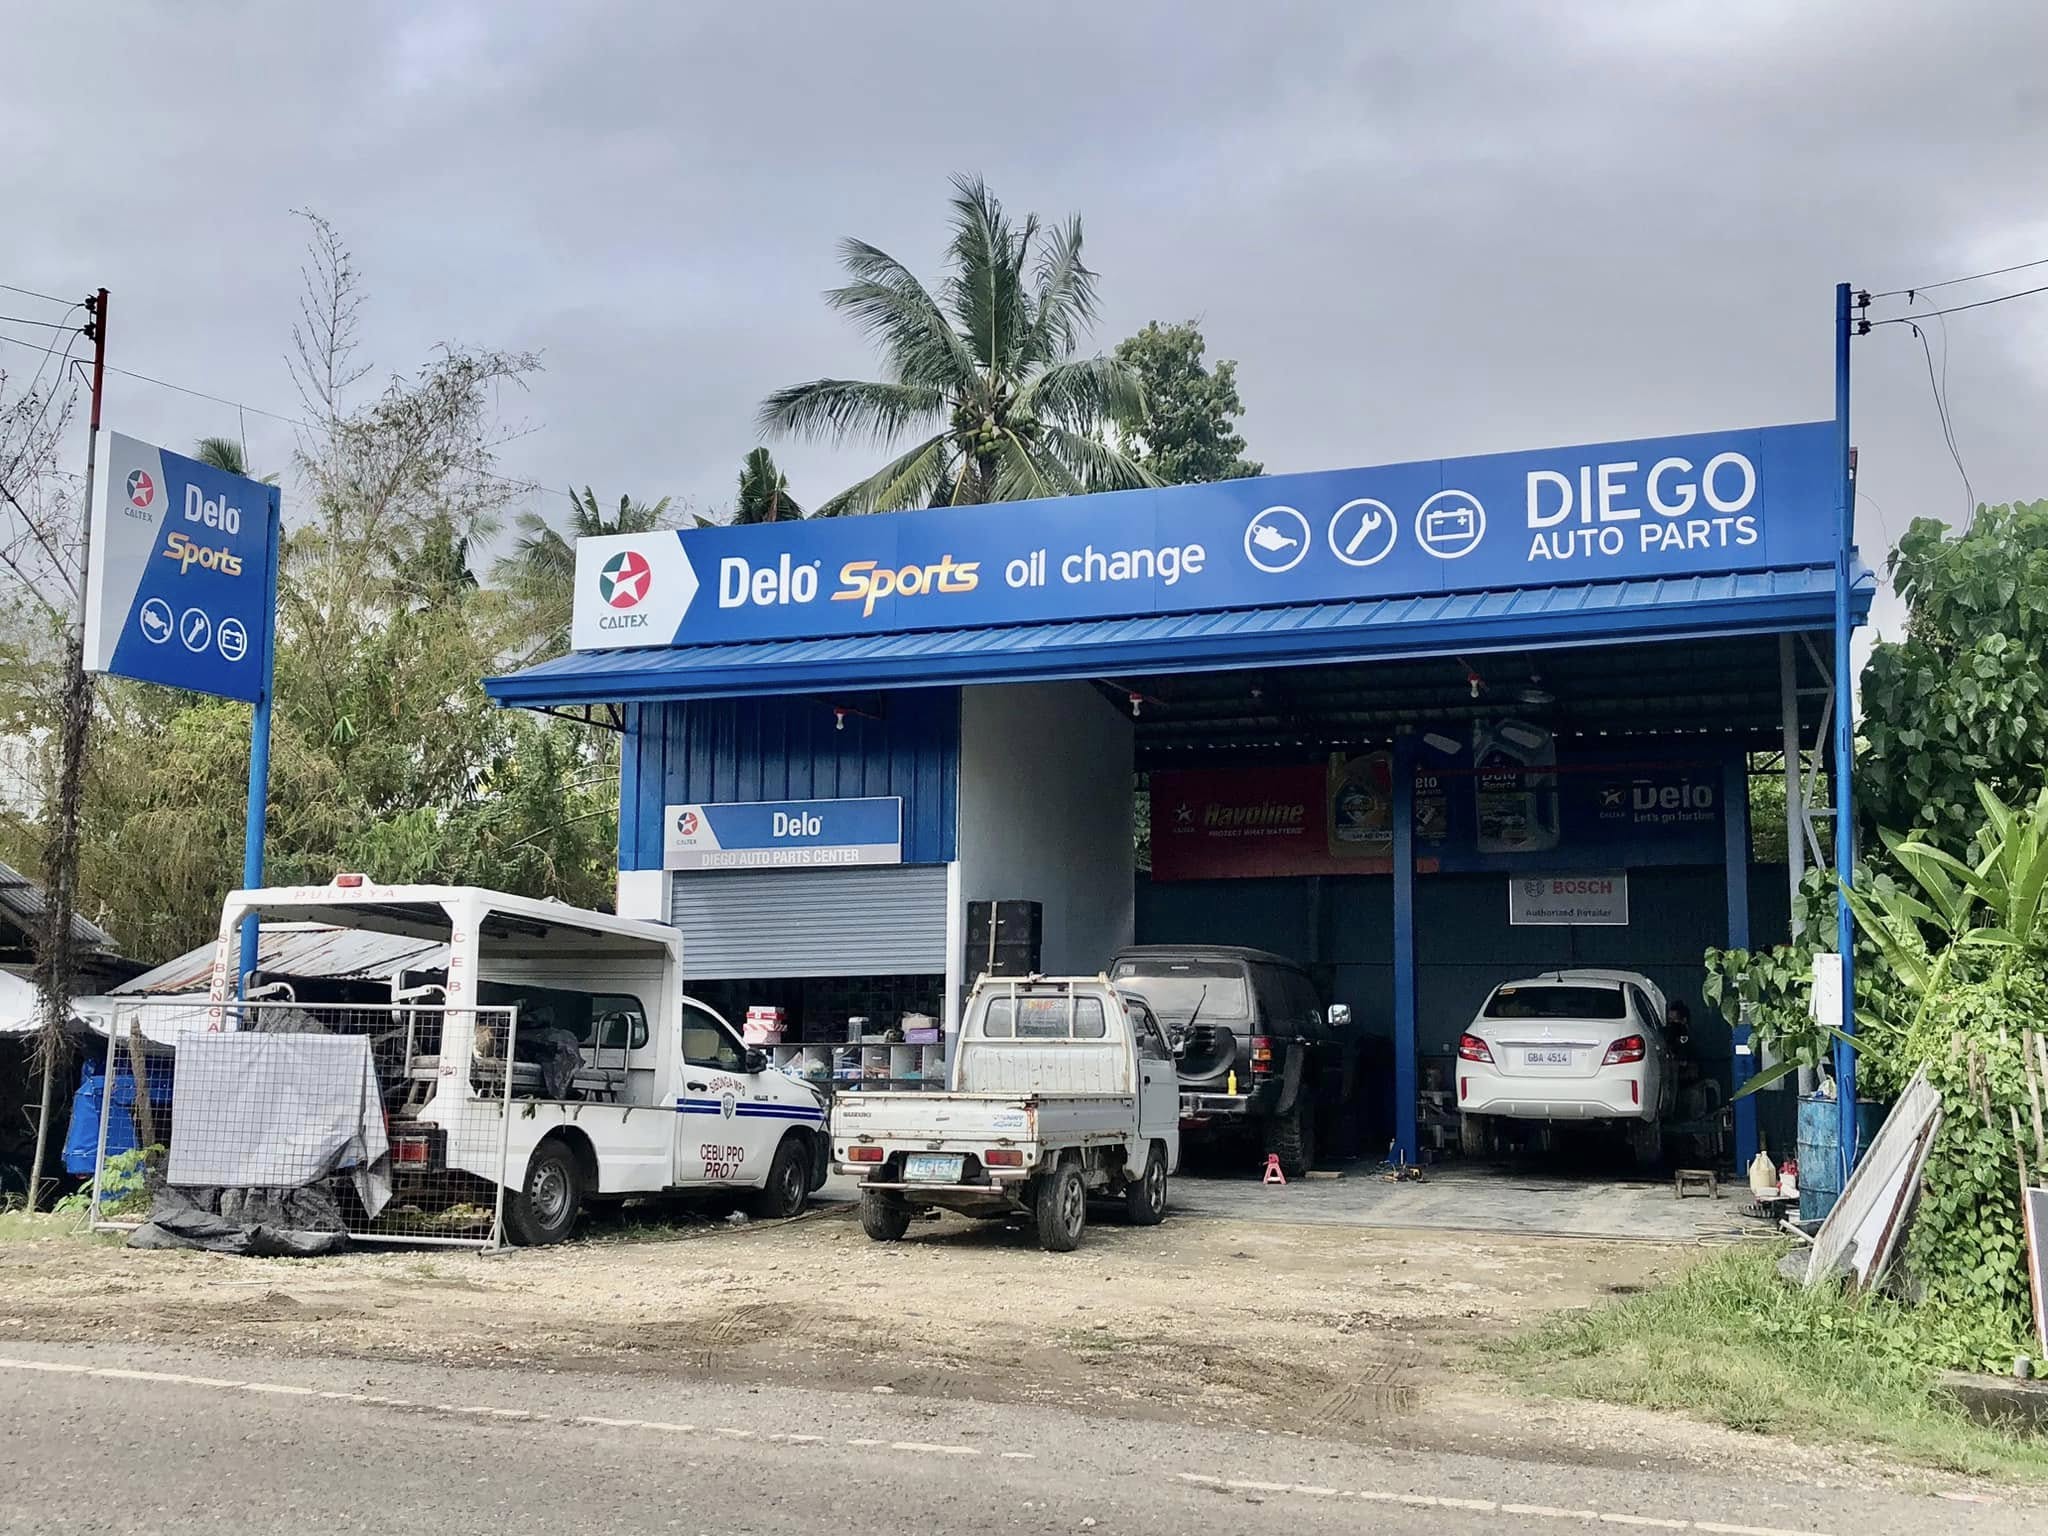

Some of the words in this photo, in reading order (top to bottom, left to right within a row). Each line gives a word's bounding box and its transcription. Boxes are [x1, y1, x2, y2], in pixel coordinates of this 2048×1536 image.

[1526, 452, 1757, 529] DIEGO
[124, 507, 153, 523] CALTEX
[184, 483, 240, 535] Delo
[1527, 526, 1624, 562] AUTO
[1640, 515, 1758, 553] PARTS
[163, 532, 242, 576] Sports
[719, 553, 820, 609] Delo
[831, 555, 979, 617] Sports
[1005, 548, 1046, 588] oil
[1061, 542, 1206, 586] change
[599, 613, 648, 630] CALTEX
[1632, 778, 1713, 810] Delo
[773, 812, 822, 837] Delo
[1206, 801, 1305, 827] Havoline
[702, 851, 736, 867] DIEGO
[739, 850, 770, 865] AUTO
[773, 849, 811, 864] PARTS
[814, 848, 860, 863] CENTER
[1552, 880, 1613, 895] BOSCH
[207, 934, 229, 1033] SIBONGA
[1527, 1052, 1544, 1063] GBA
[1547, 1052, 1568, 1063] 4514
[700, 1143, 724, 1161] CEBU
[726, 1146, 744, 1163] PPO
[704, 1161, 730, 1179] PRO
[730, 1163, 739, 1178] 7
